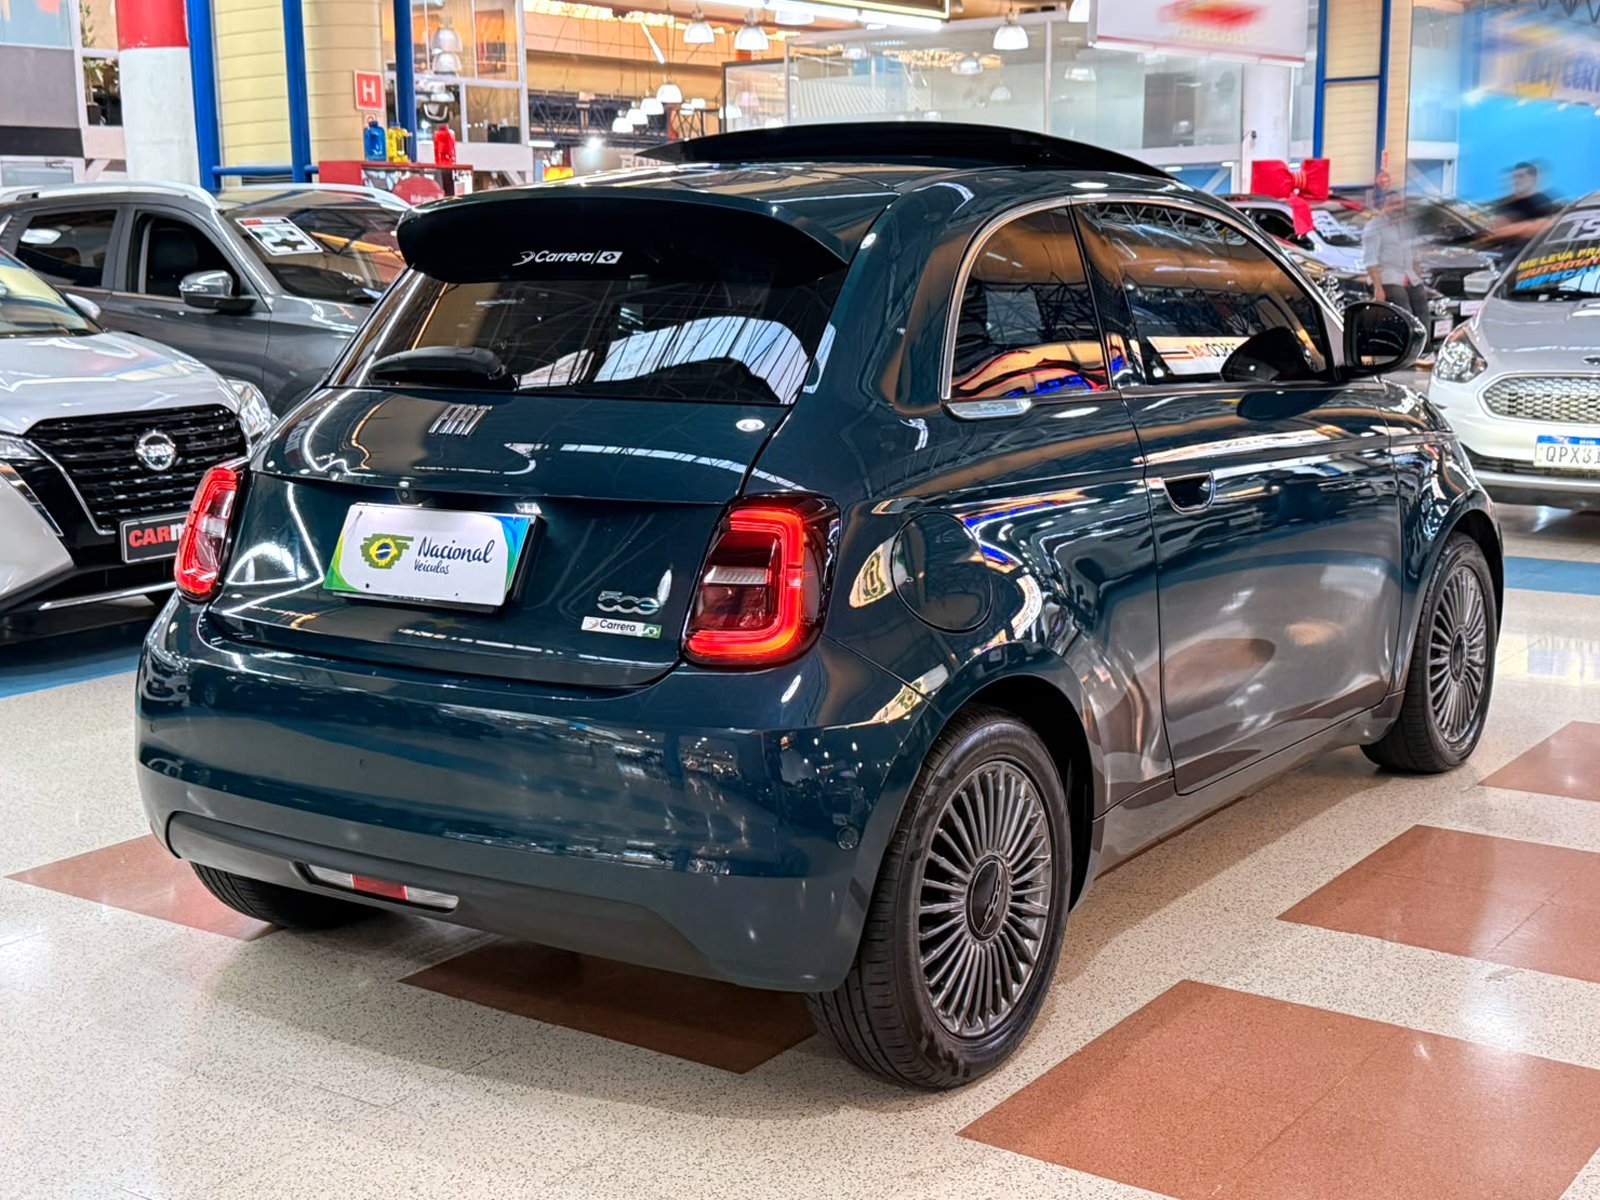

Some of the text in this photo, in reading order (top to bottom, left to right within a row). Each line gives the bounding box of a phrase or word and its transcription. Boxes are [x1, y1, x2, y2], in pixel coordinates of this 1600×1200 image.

[362, 80, 376, 103] H
[535, 250, 594, 263] Carrera
[1518, 258, 1539, 270] ME
[1540, 251, 1574, 265] LEVA
[428, 404, 493, 435] FIAT
[417, 536, 495, 564] Nacional
[600, 619, 637, 632] Carrera
